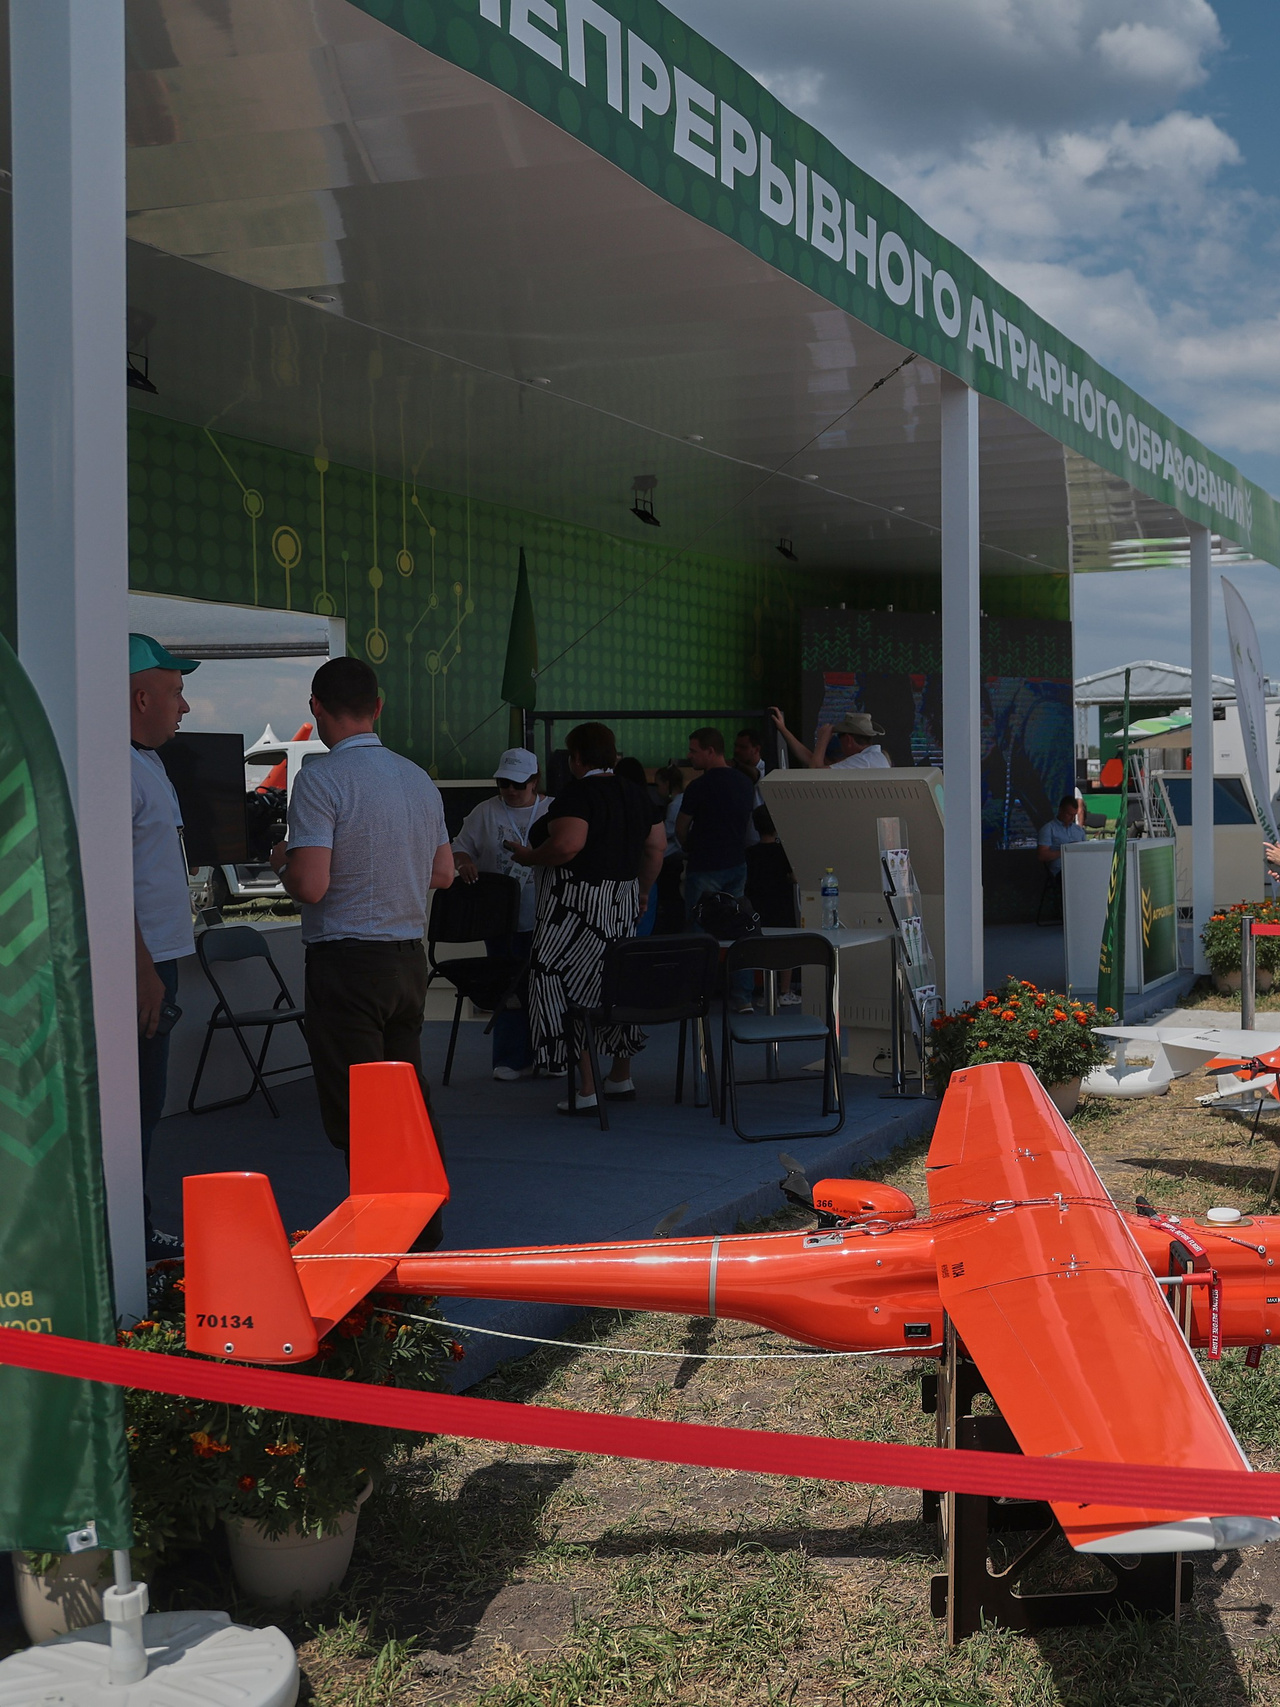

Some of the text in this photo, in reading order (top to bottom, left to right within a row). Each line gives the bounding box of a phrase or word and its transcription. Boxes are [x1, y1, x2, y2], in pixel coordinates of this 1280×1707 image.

[479, 0, 1246, 529] ЕПРЕРЫВНОГО АГРАРНОГО ОБРАЗОВАНИЯ
[816, 1199, 833, 1208] 366
[1186, 1239, 1203, 1253] FLIGHT
[196, 1313, 254, 1329] 70134
[1211, 1312, 1219, 1334] BEFORE
[1211, 1334, 1219, 1355] FLIGHT
